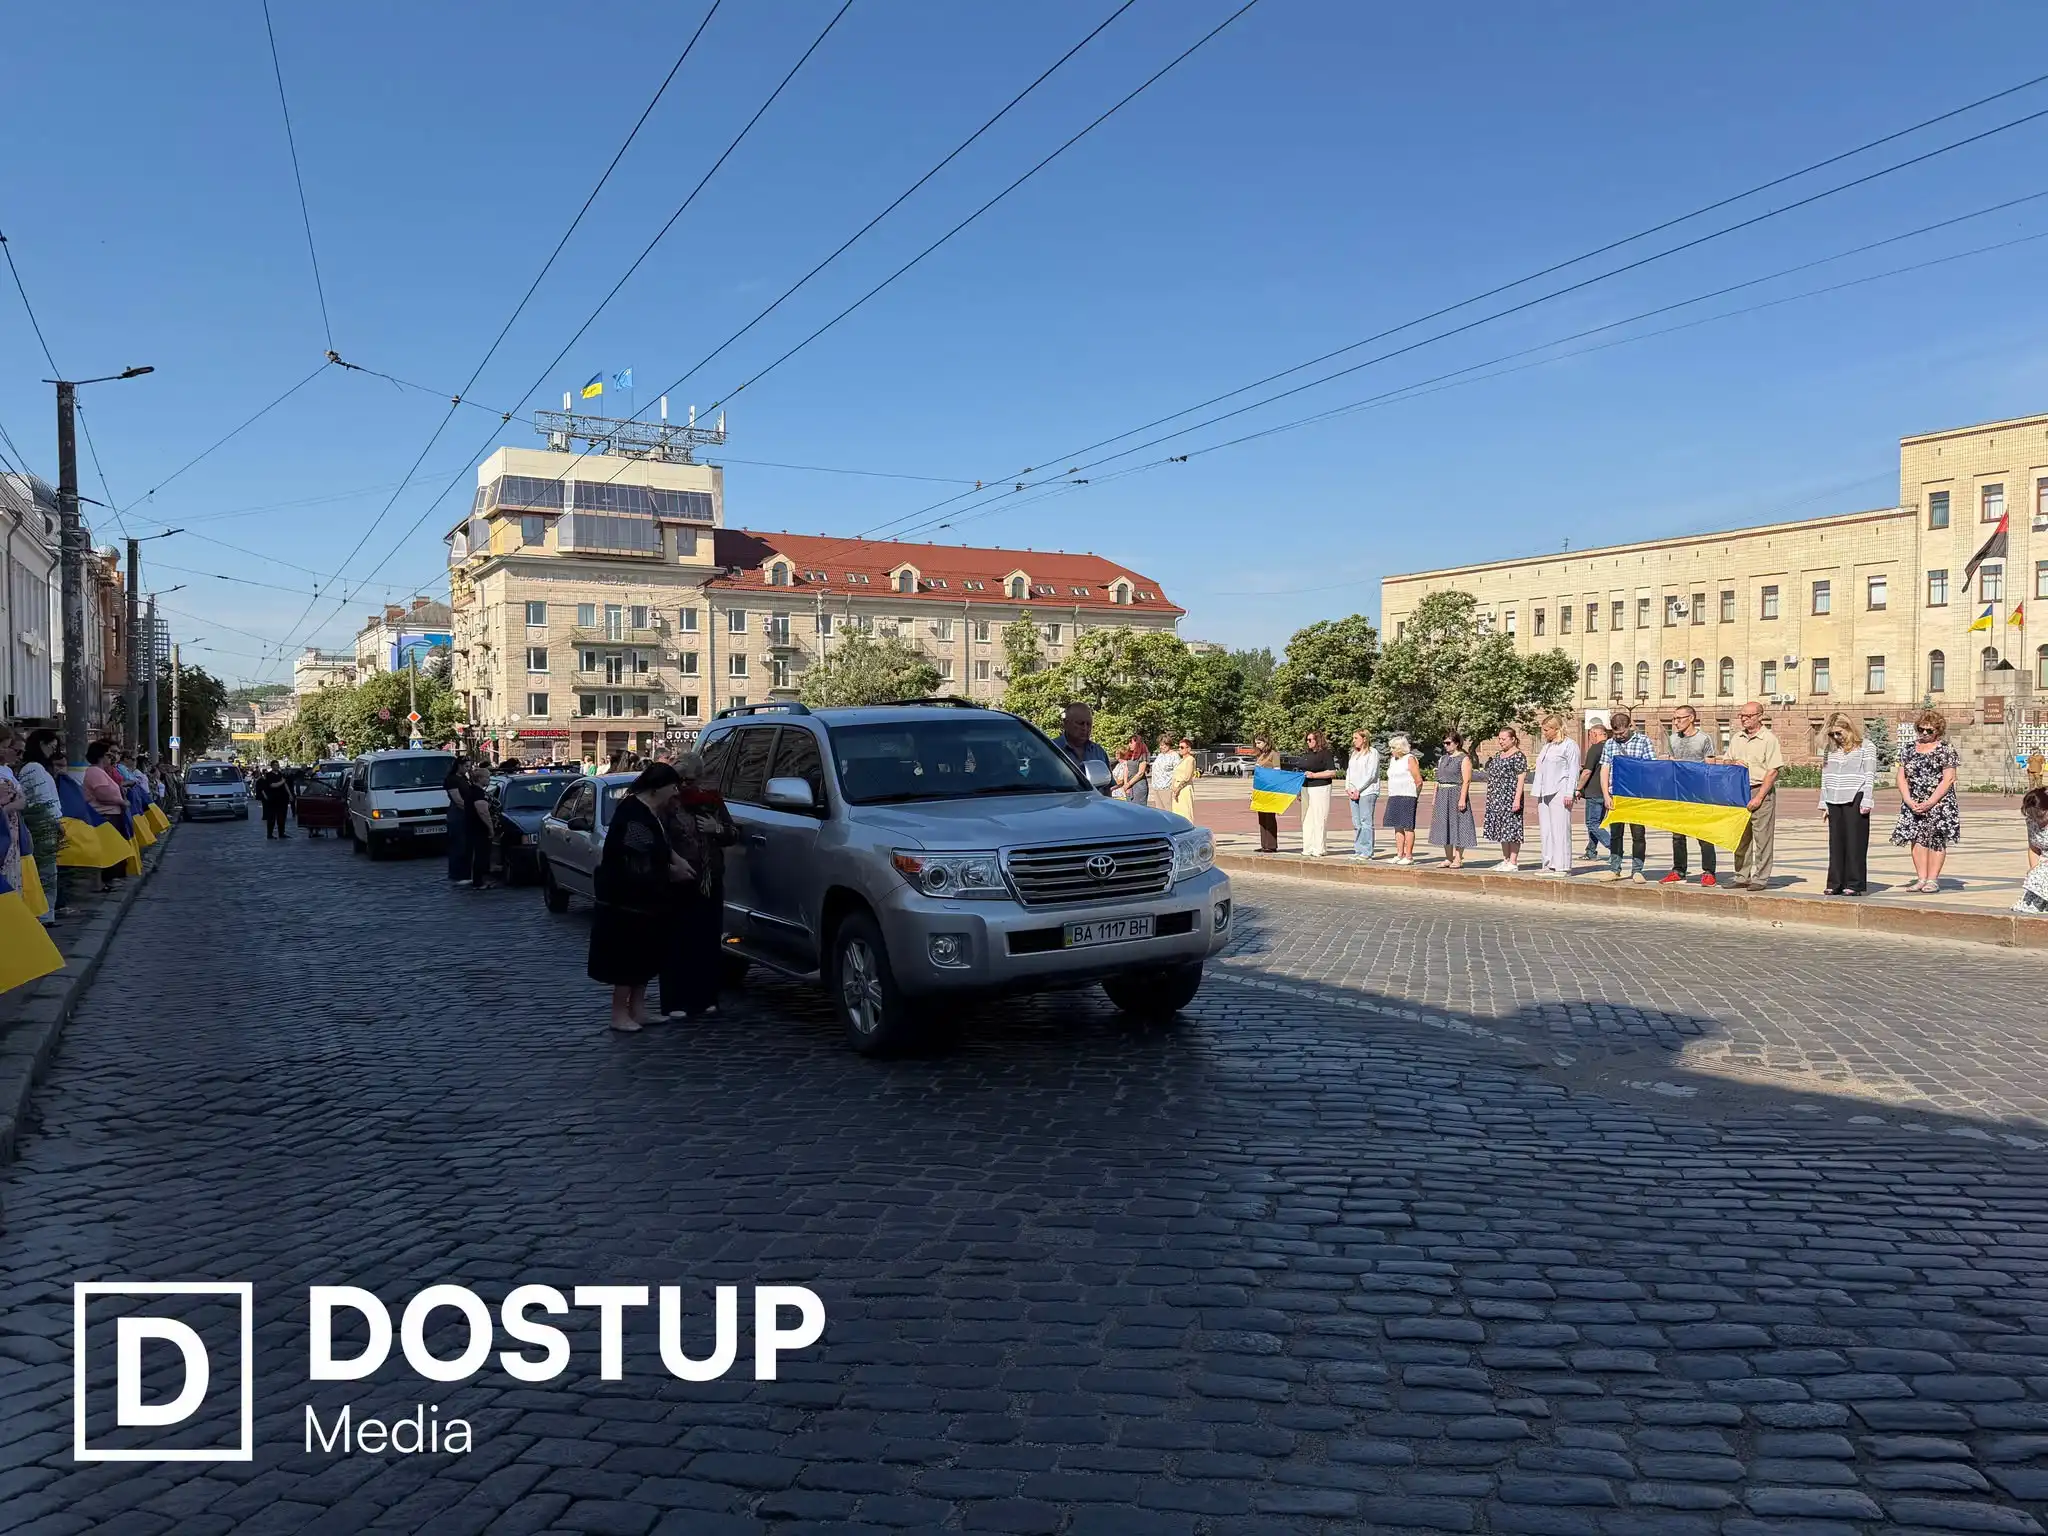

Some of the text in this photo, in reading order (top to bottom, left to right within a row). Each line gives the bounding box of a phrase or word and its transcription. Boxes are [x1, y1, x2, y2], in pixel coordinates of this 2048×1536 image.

[666, 731, 699, 740] GOGO
[1074, 919, 1149, 942] BA 1117 BH
